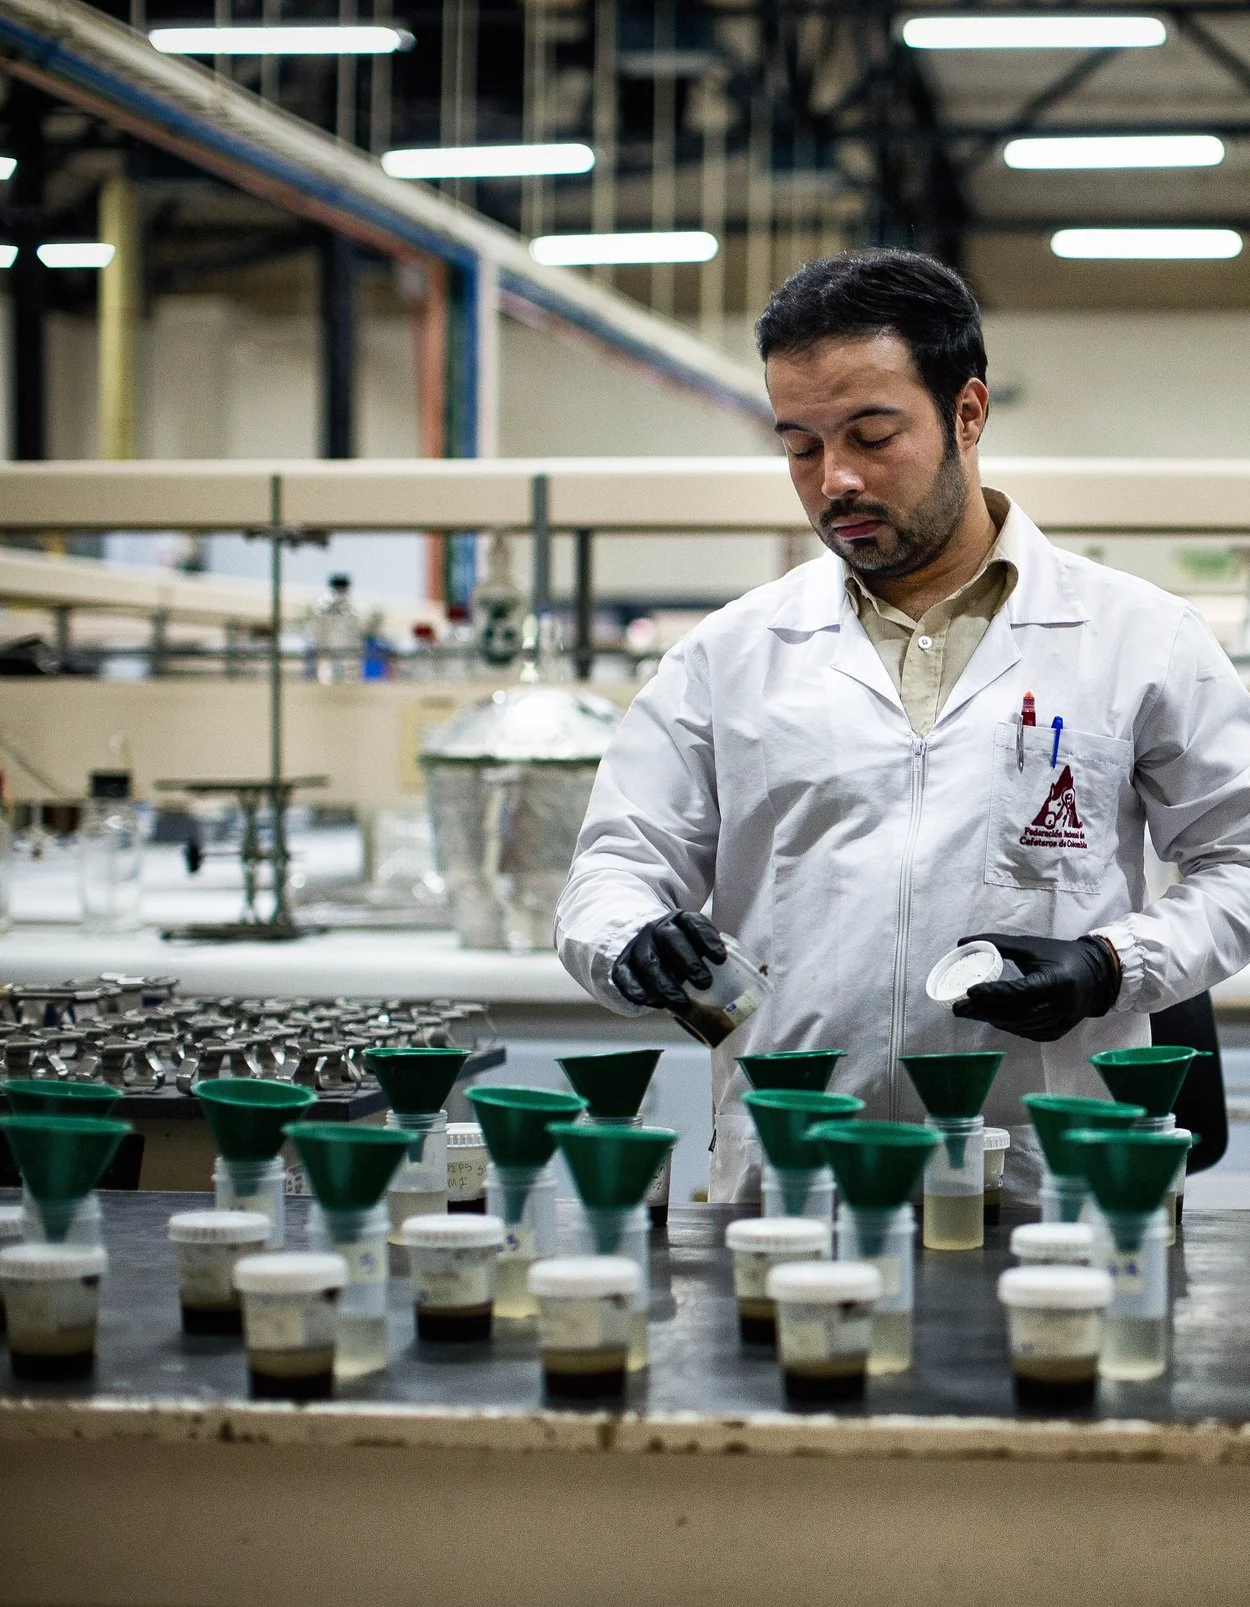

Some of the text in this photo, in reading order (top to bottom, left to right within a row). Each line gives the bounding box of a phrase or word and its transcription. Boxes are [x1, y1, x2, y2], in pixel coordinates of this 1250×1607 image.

[1024, 827, 1062, 838] Federación
[1019, 836, 1057, 847] Cafeteros
[1067, 840, 1087, 849] Colombia
